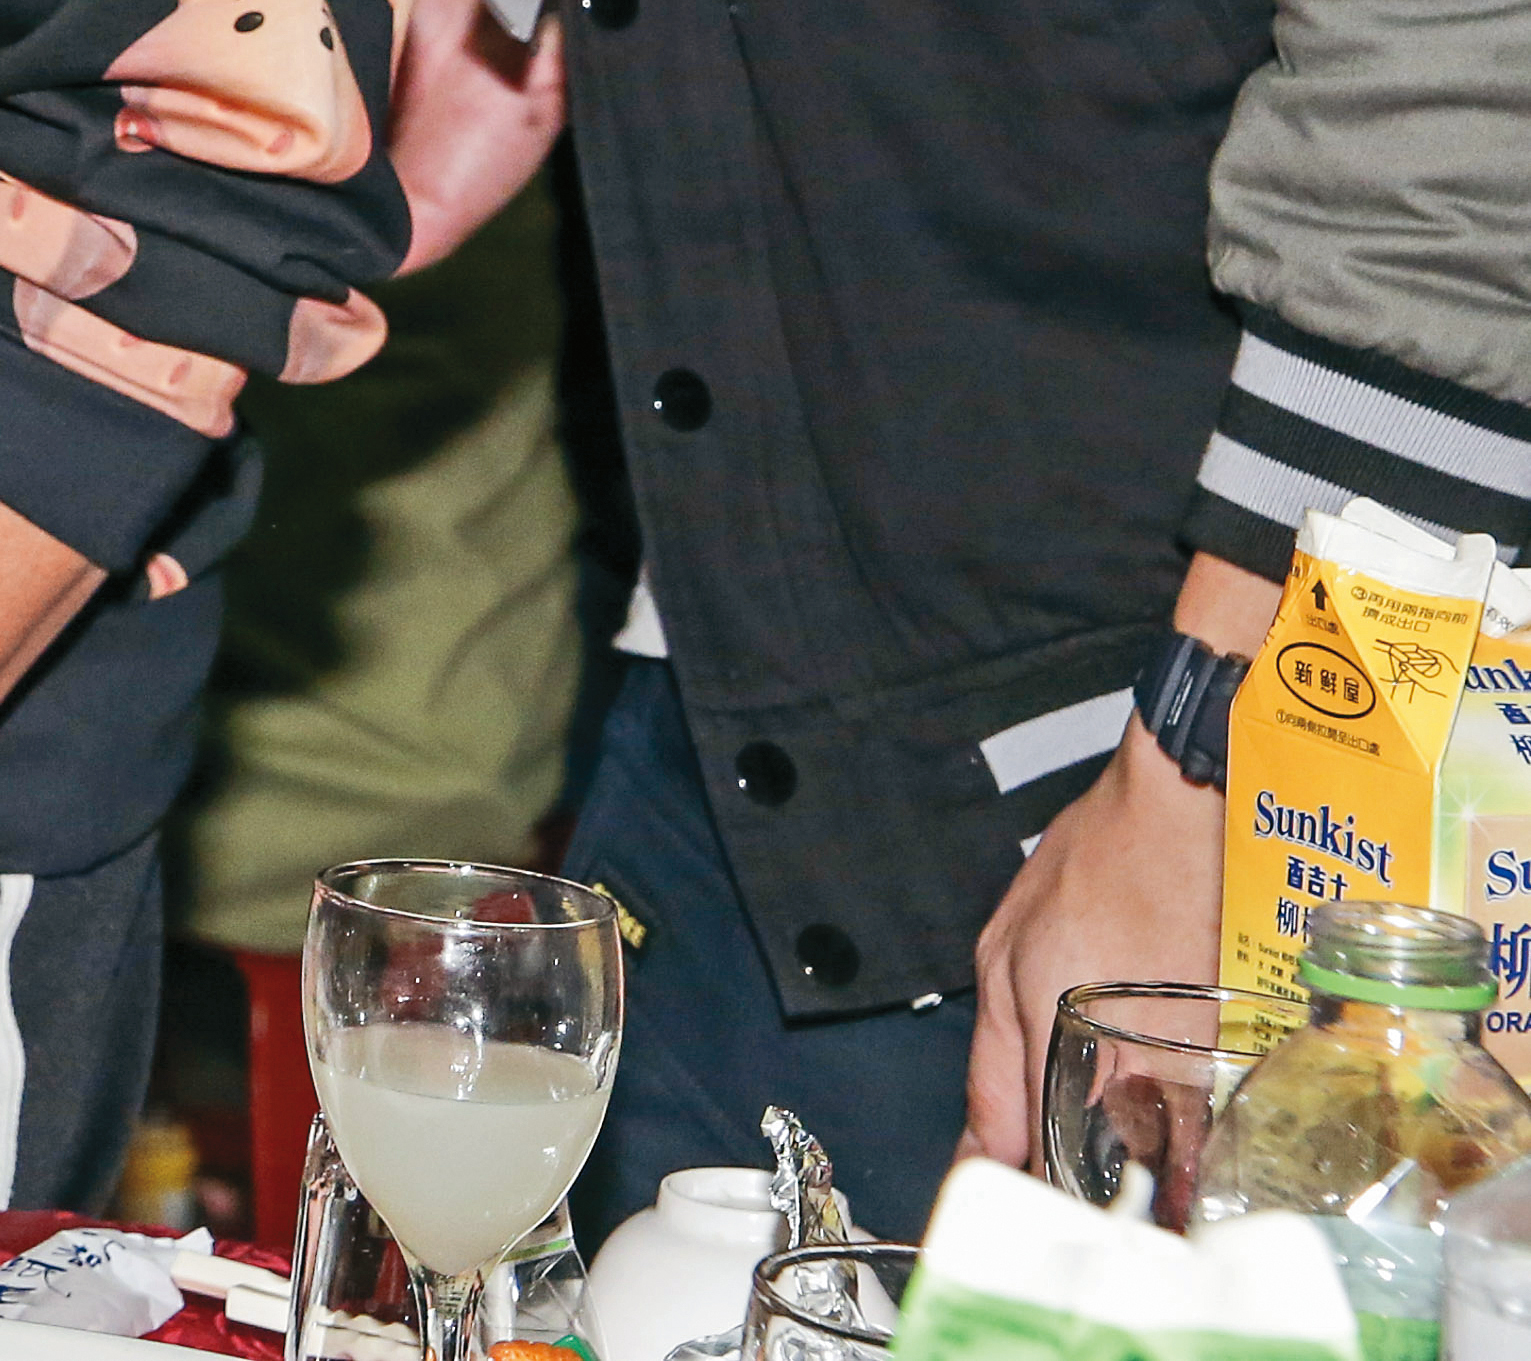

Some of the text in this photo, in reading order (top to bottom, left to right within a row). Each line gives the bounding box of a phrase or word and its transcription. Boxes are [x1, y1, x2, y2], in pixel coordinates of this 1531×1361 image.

[1253, 790, 1394, 887] Sunkist
[1285, 855, 1349, 903] 香吉士
